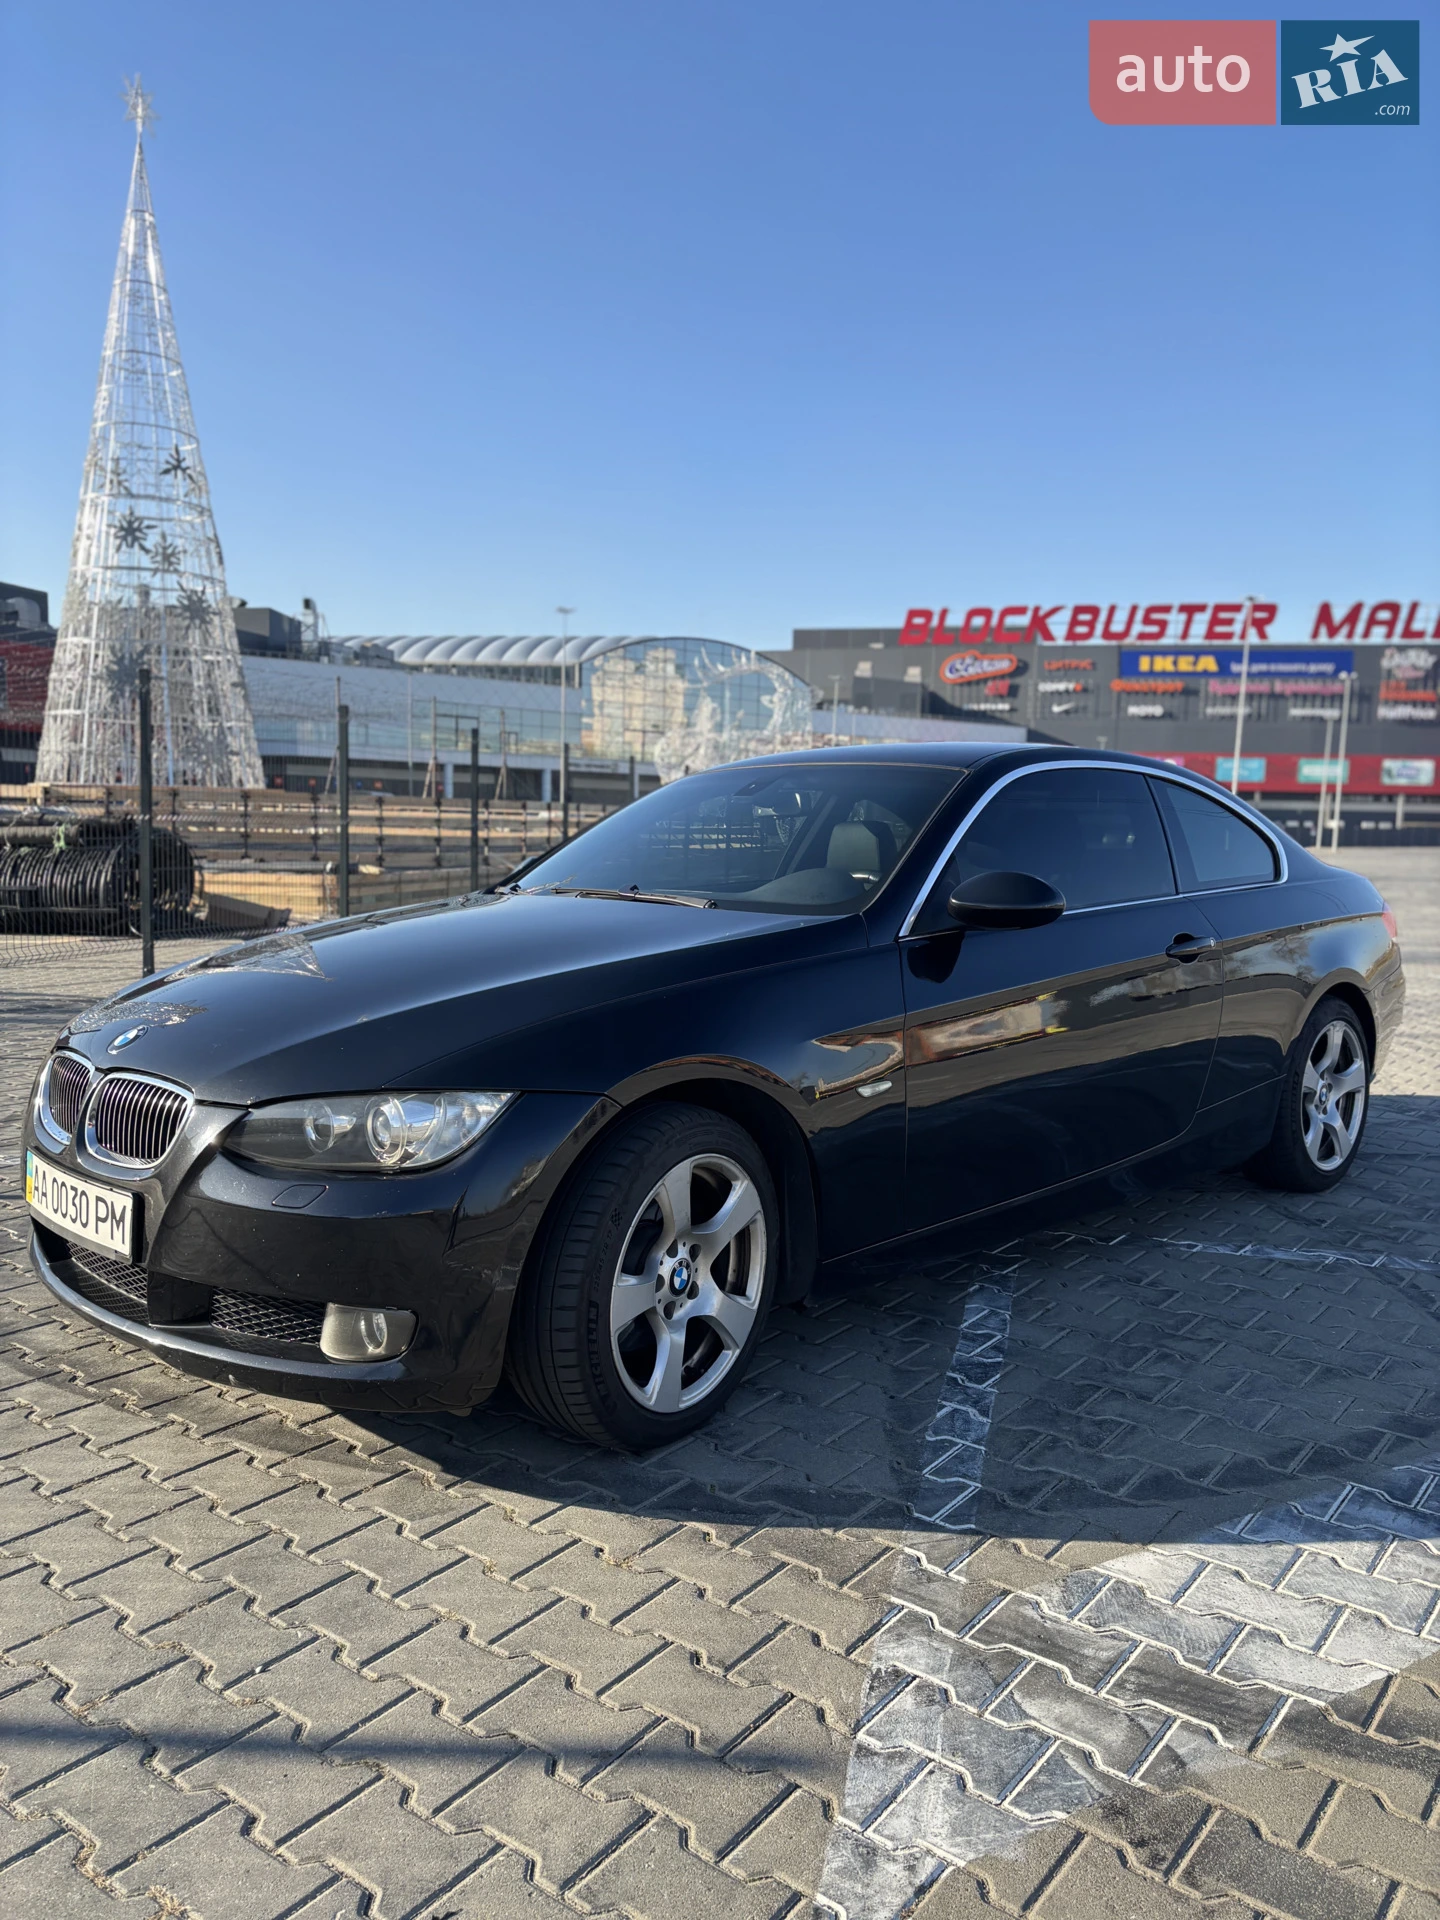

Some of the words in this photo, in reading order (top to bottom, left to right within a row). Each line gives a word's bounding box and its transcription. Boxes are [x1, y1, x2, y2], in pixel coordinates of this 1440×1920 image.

[897, 602, 1278, 646] BLOCKBUSTER
[1138, 655, 1219, 673] IKEA
[32, 1164, 49, 1210] AA
[52, 1176, 90, 1229] 0030
[95, 1194, 127, 1246] PM
